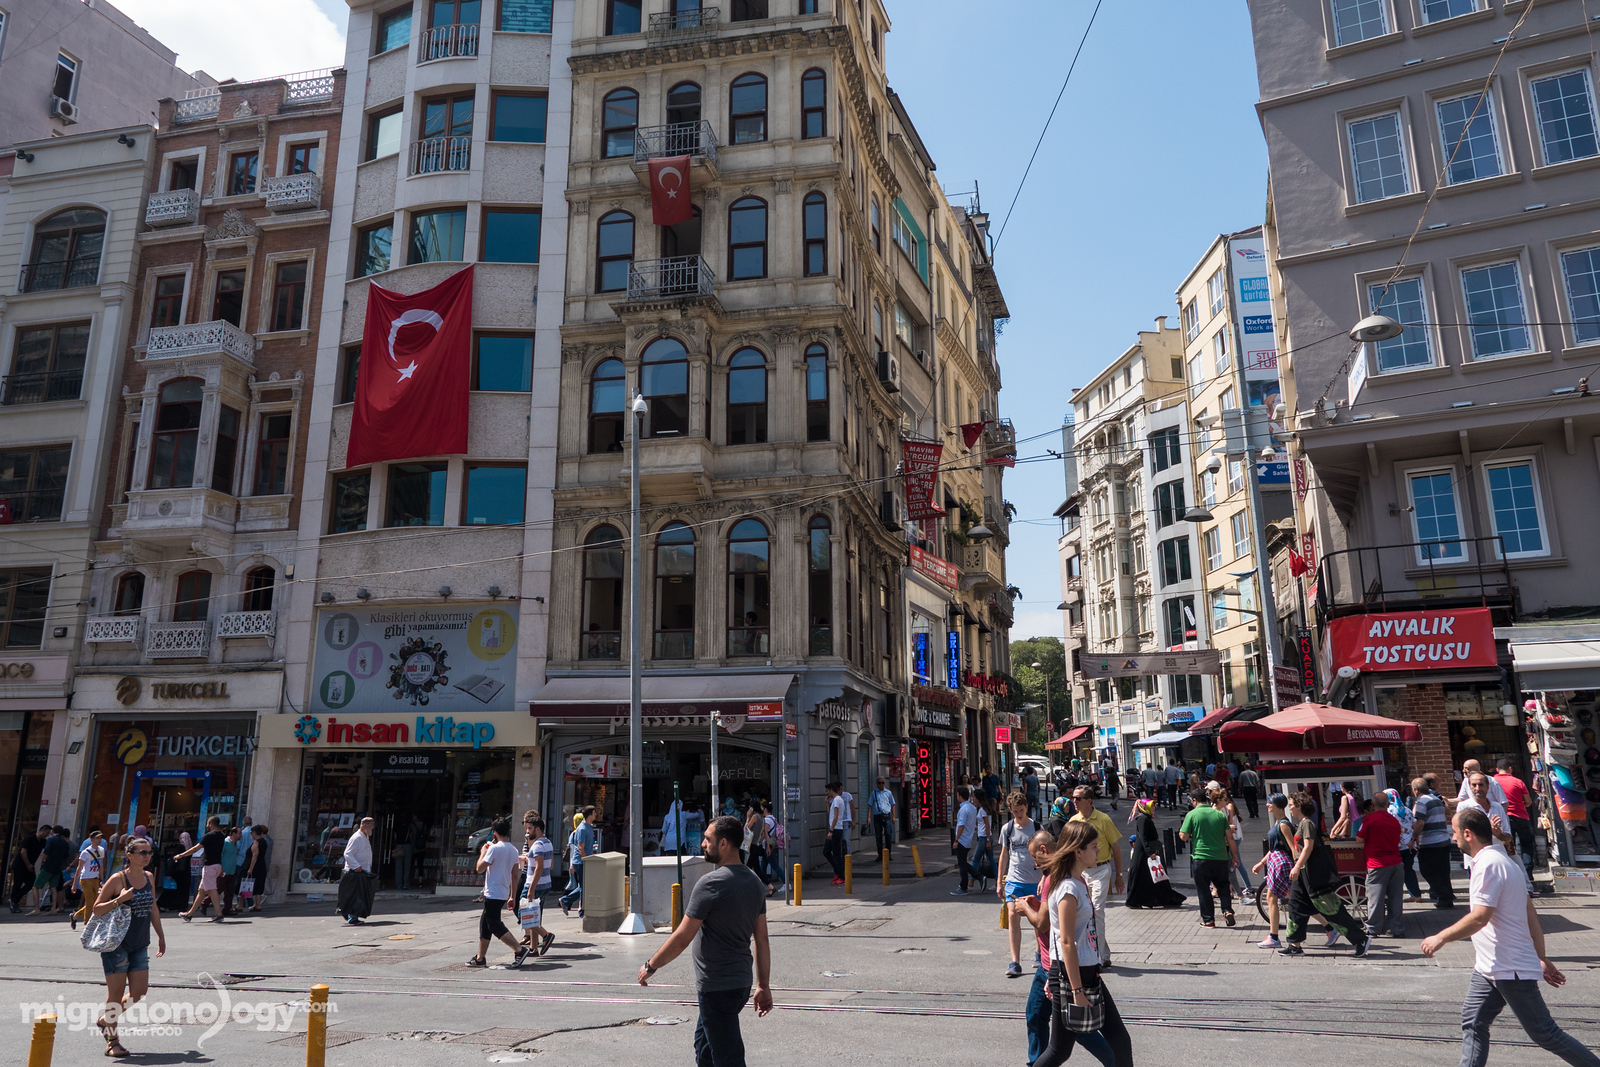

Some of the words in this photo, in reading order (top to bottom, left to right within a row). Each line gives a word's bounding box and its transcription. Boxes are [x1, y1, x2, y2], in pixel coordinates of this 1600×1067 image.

[909, 446, 934, 454] MAVİM
[1303, 536, 1315, 576] NOTER
[370, 612, 416, 623] Klasikleri
[418, 611, 473, 624] okuyormuş
[1368, 616, 1455, 638] AYVALIK
[384, 623, 406, 640] gibi
[949, 632, 958, 688] EKİKÜR
[1300, 637, 1315, 687] KUAFÖR
[1363, 641, 1471, 664] TOSTCUSU
[151, 681, 231, 699] TURKCELL
[326, 716, 409, 743] insan
[415, 715, 495, 749] kitap
[919, 748, 929, 818] DÖVİZ
